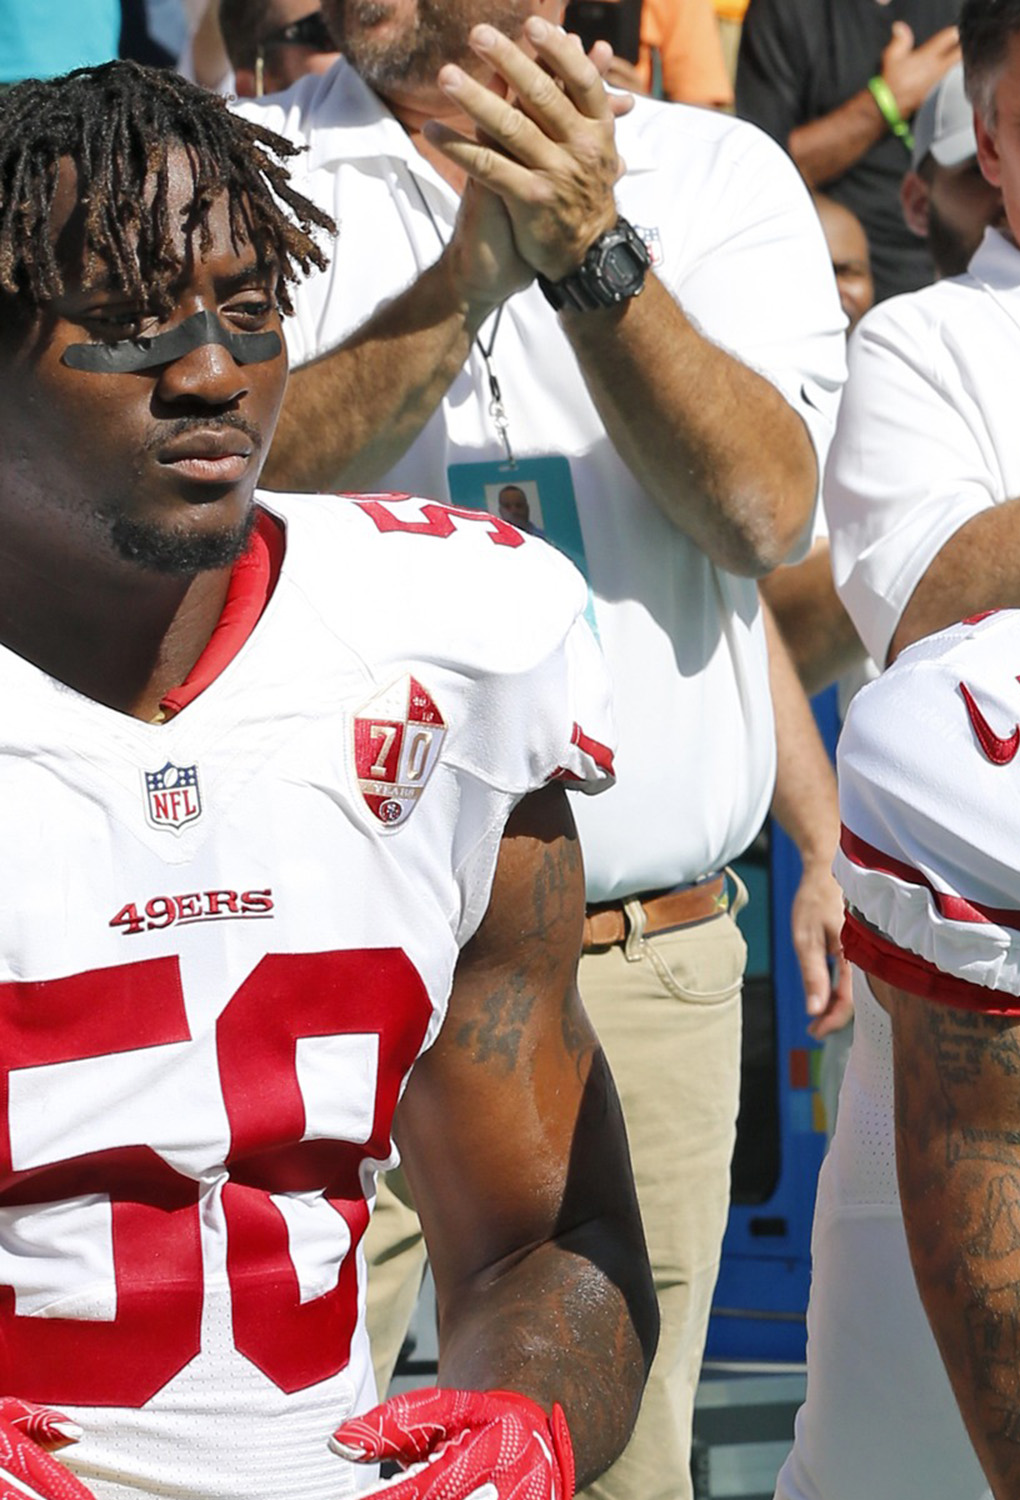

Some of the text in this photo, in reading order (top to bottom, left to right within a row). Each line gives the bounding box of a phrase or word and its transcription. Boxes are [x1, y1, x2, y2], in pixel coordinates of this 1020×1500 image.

[336, 491, 525, 548] 5
[370, 725, 433, 781] 70
[153, 789, 197, 821] NFL
[373, 784, 416, 797] YEARS
[109, 888, 274, 936] 49ERS
[0, 947, 433, 1408] 58
